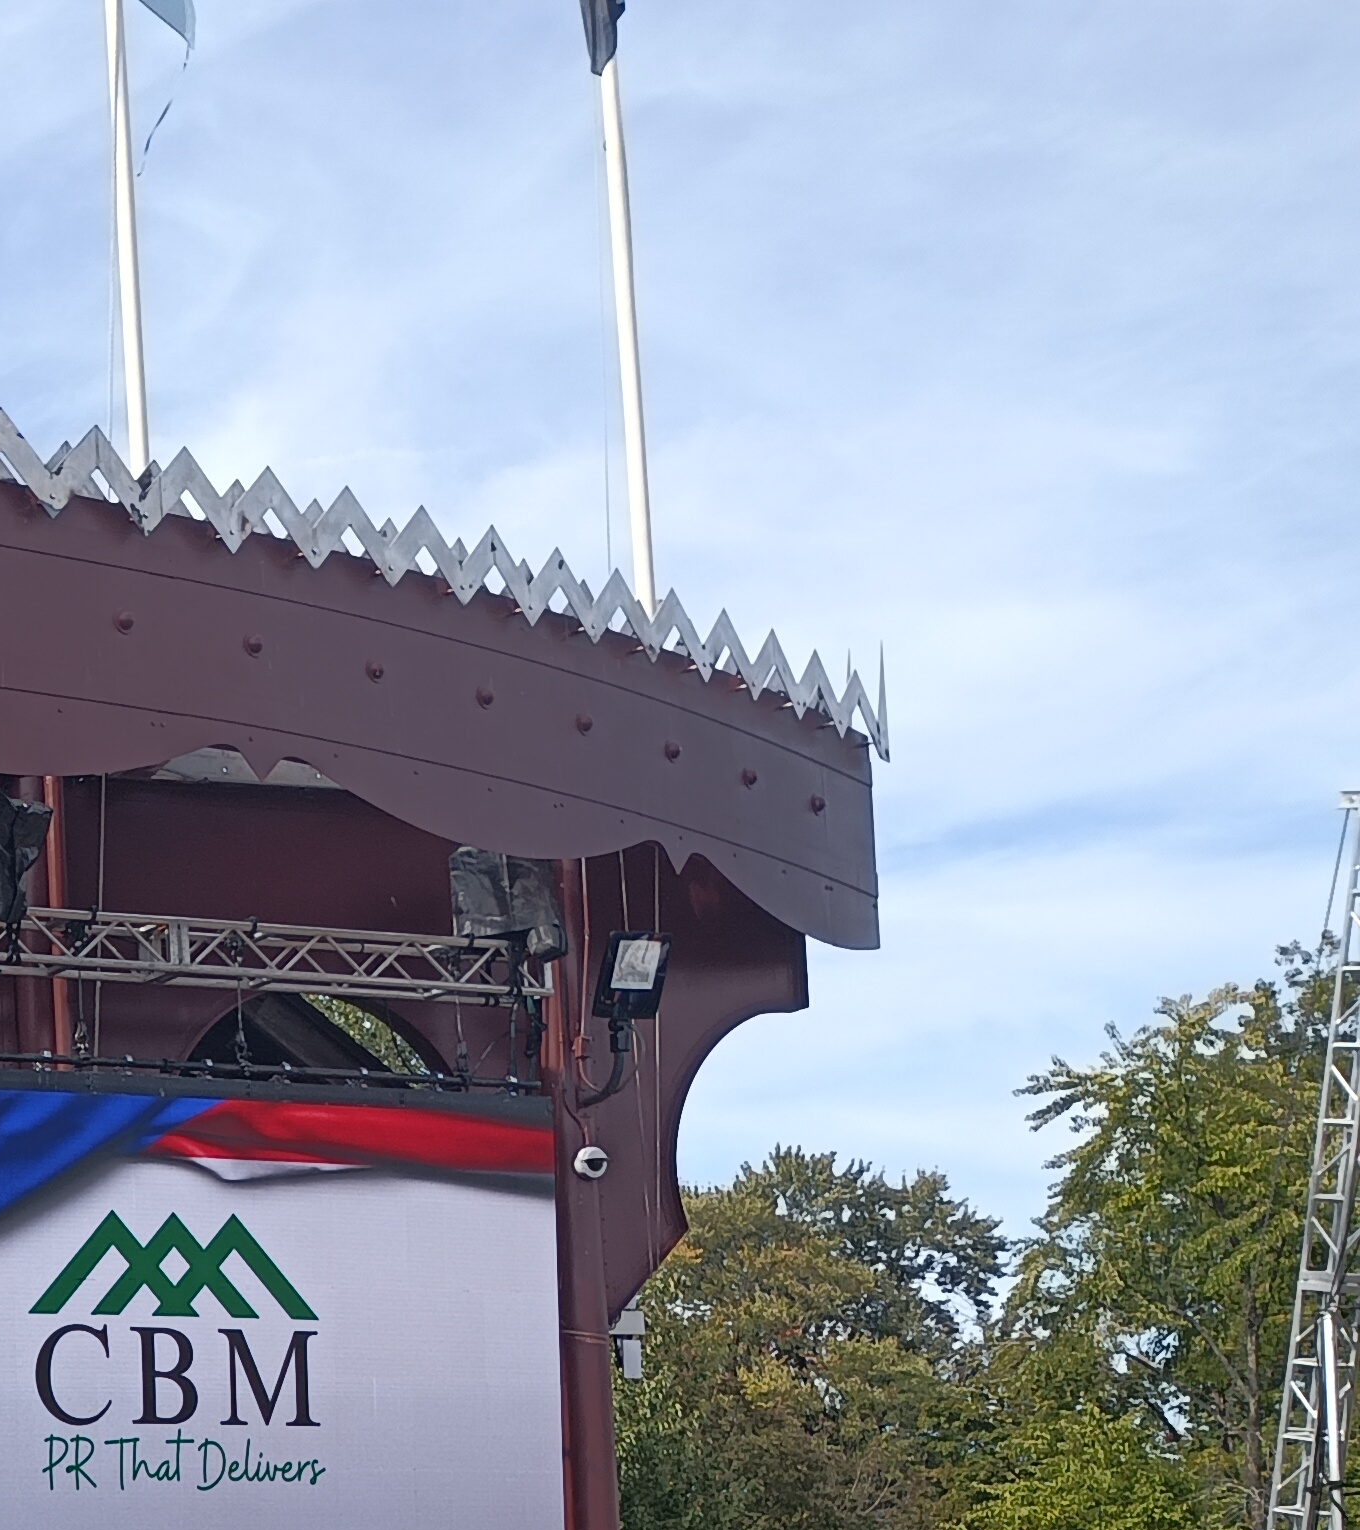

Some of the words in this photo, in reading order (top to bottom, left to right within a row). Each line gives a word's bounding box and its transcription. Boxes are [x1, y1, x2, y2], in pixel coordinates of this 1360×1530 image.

[35, 1323, 321, 1427] CBM
[42, 1433, 98, 1490] PR
[104, 1428, 194, 1490] That
[197, 1438, 326, 1491] Delivers
